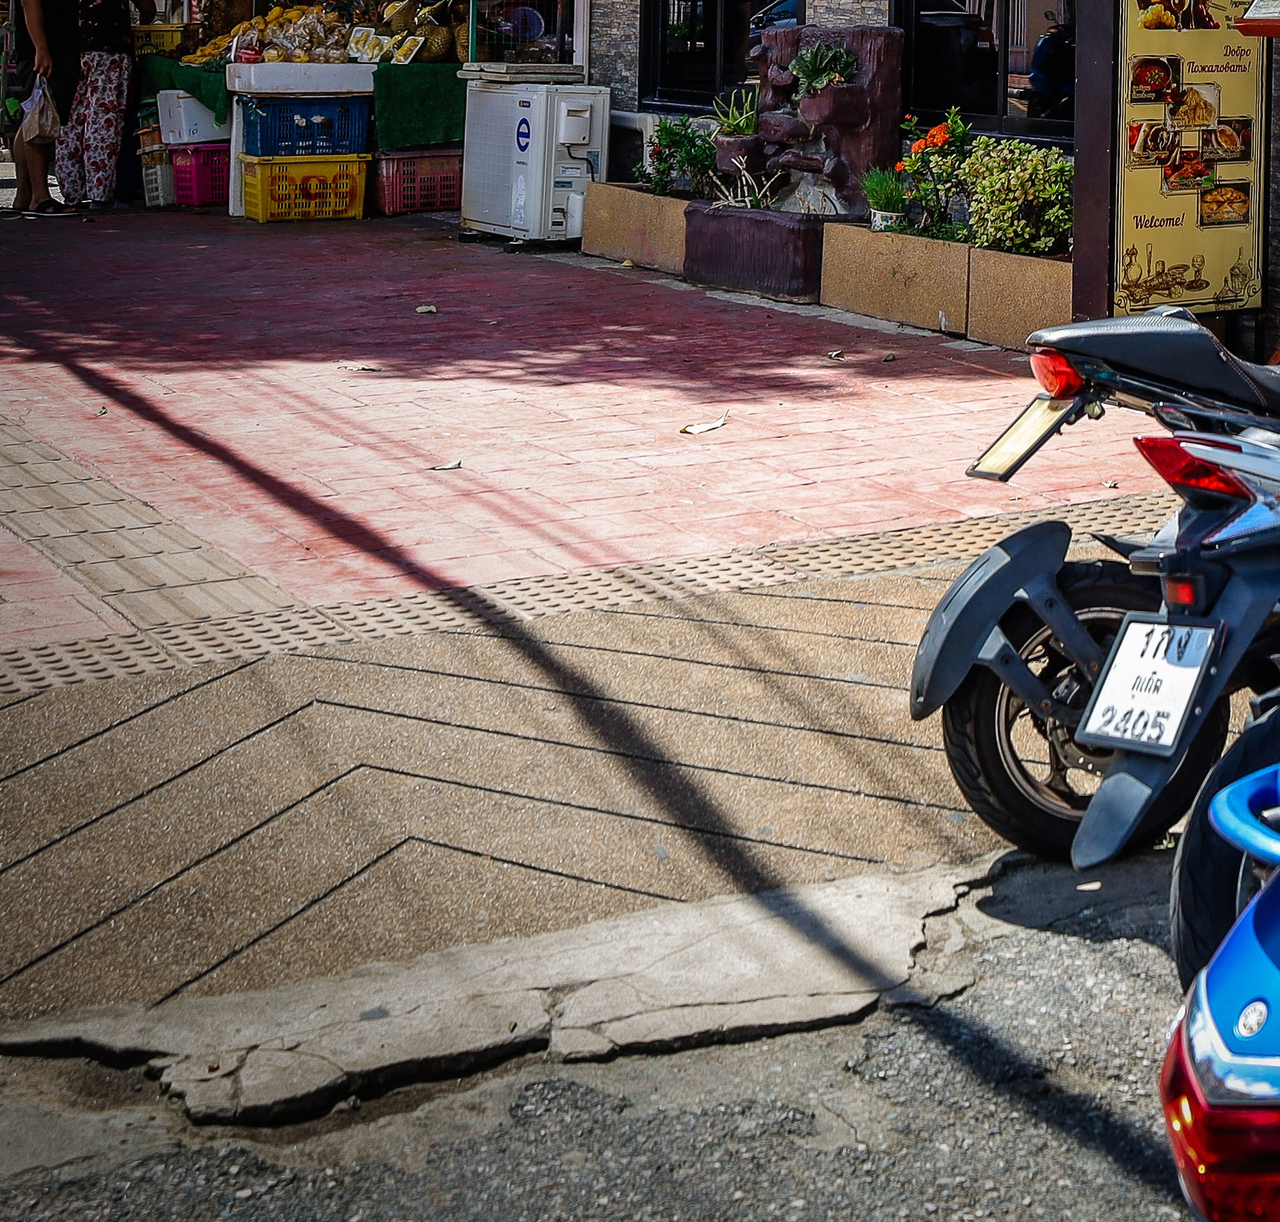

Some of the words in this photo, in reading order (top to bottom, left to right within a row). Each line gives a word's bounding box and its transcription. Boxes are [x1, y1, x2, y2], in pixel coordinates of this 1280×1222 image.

[1223, 45, 1252, 63] Добро
[1186, 61, 1252, 75] Пожаловать!
[1133, 212, 1186, 230] Welcome!
